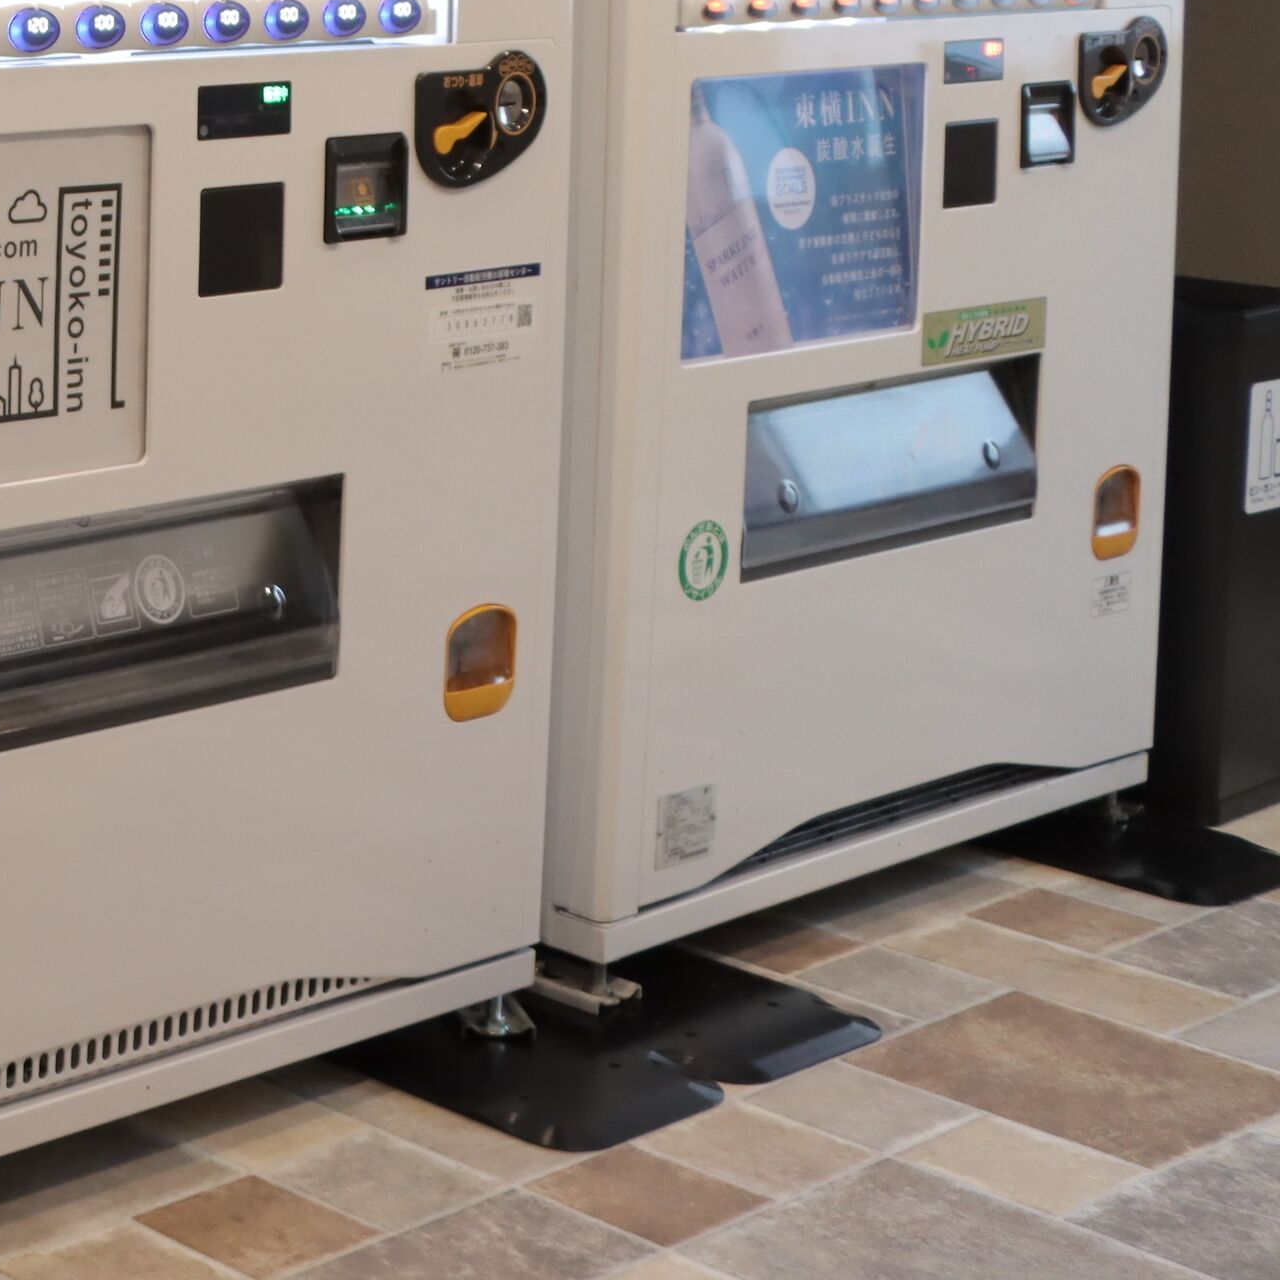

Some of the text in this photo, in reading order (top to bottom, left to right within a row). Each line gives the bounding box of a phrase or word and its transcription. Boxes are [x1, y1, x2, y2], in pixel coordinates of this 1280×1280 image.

[28, 17, 48, 33] 120
[793, 87, 895, 128] 東横INN
[65, 197, 93, 413] toyoko-inn
[945, 313, 1030, 358] HYBRID
